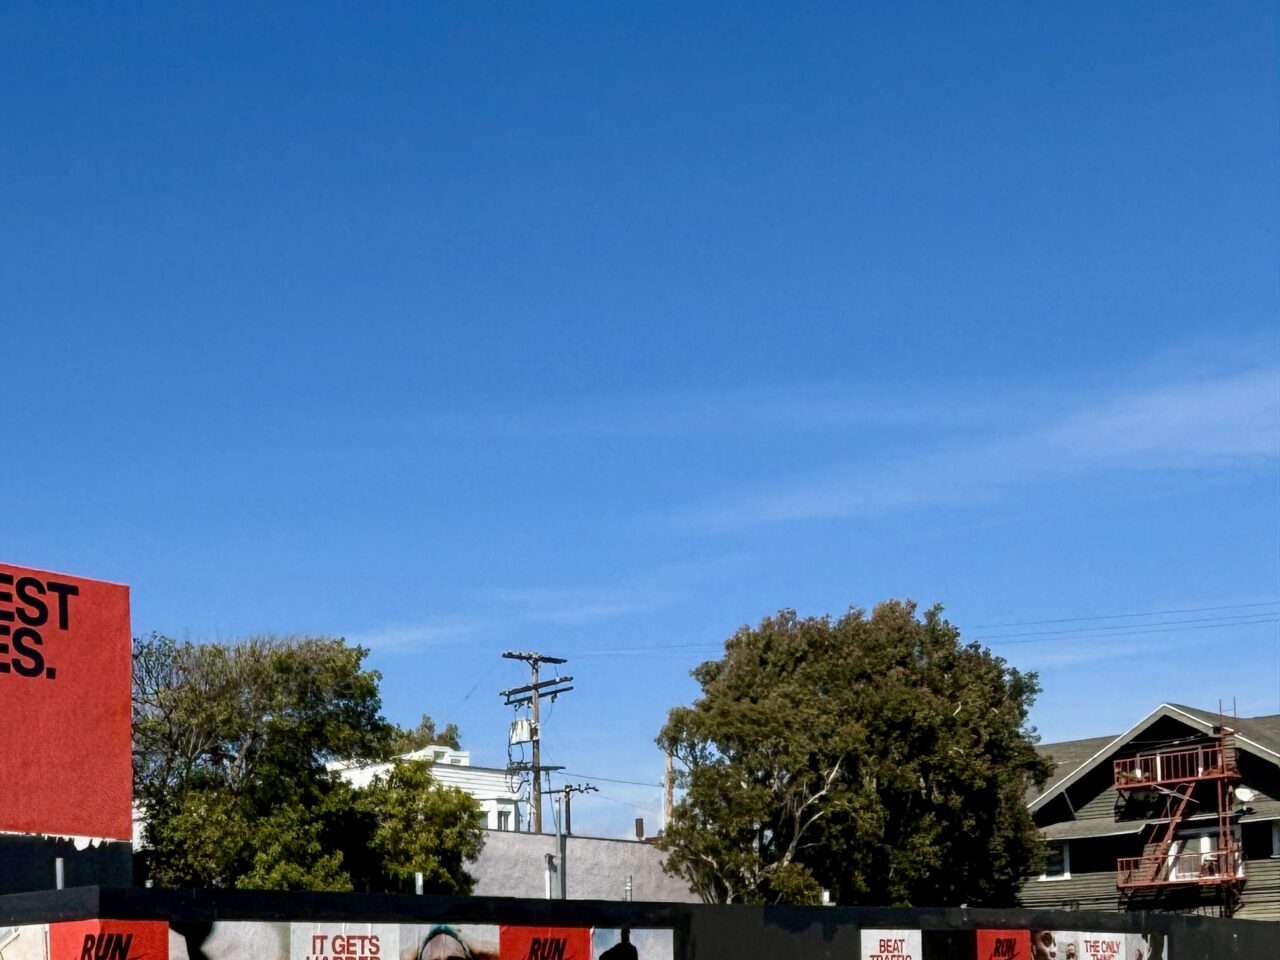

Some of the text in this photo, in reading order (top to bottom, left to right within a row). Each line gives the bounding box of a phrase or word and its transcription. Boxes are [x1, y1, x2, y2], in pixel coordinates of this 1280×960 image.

[311, 935, 380, 955] IT GETS
[879, 939, 905, 954] BEAT
[993, 938, 1016, 958] RUN
[1084, 940, 1120, 953] THE ONLY
